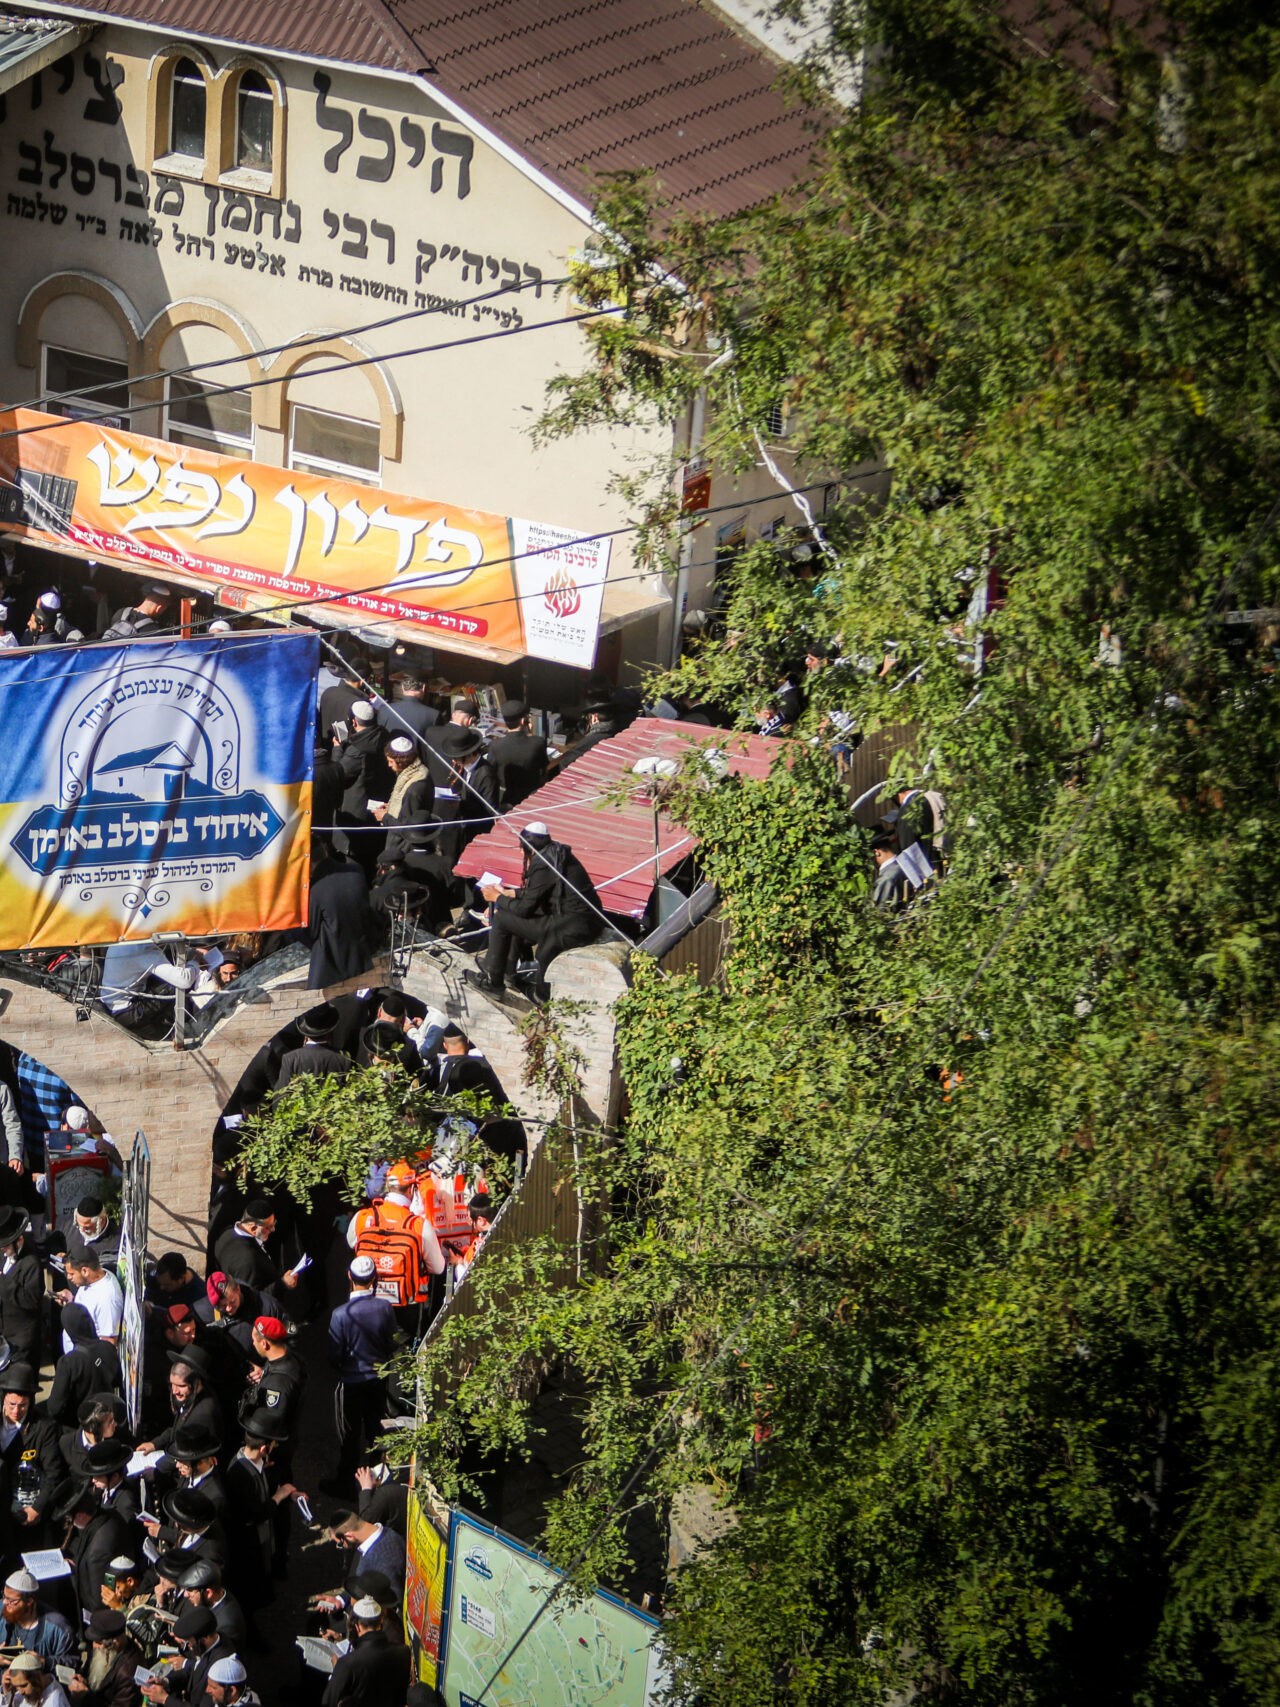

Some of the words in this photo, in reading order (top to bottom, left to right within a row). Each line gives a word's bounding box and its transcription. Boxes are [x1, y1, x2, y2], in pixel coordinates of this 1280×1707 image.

[313, 70, 475, 201] היכל
[18, 129, 185, 216] מברסלב
[7, 191, 67, 225] שלמה
[204, 186, 302, 244] נחמן
[119, 217, 163, 246] לאה
[172, 223, 215, 261] רחל
[322, 207, 396, 265] רבי
[224, 241, 287, 277] אלטע
[297, 263, 334, 289] מרת
[339, 273, 408, 306] החשובה
[415, 290, 467, 319] האשה
[86, 441, 257, 542] נפש
[106, 537, 146, 555] מברסלב
[273, 484, 483, 596] פדיון
[149, 547, 173, 561] נחמן
[175, 554, 203, 569] רבינו
[564, 552, 598, 568] לרבינו
[206, 562, 230, 576] ספרי
[232, 568, 266, 584] והפצת
[268, 577, 311, 594] להדפסת
[381, 603, 396, 614] דב
[398, 605, 435, 620] ישראל
[437, 614, 456, 626] רבי
[459, 619, 478, 633] קרן
[112, 679, 173, 704] עצמכם
[177, 681, 224, 722] תחזיקו
[78, 697, 115, 729] ביחד
[108, 811, 189, 849] ברסלב
[193, 812, 268, 841] איחוד
[28, 824, 103, 863] באומן
[59, 871, 93, 888] באומן
[94, 867, 130, 883] ברסלב
[163, 863, 198, 878] לניהול
[200, 861, 236, 874] המרכז
